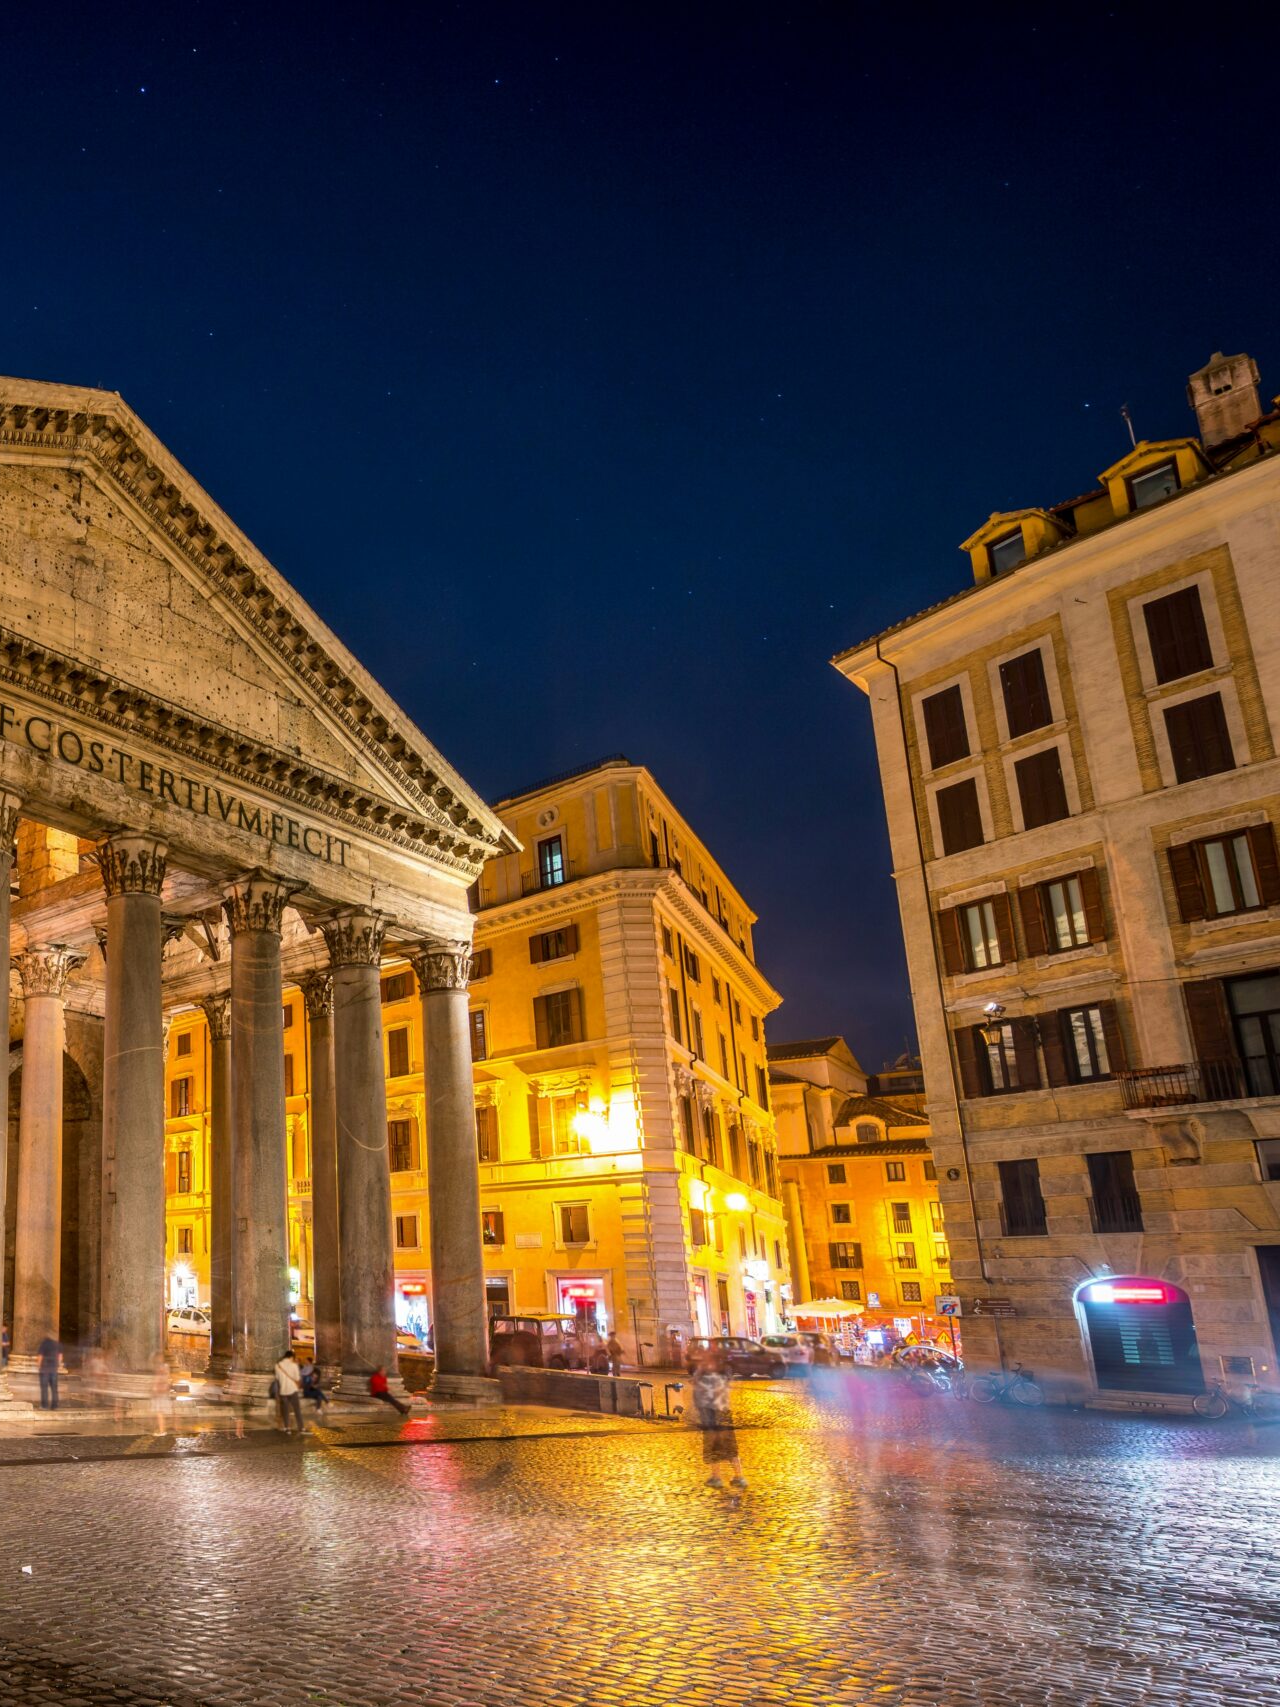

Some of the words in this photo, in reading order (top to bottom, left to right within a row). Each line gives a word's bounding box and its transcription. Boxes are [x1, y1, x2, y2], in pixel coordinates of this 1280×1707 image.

[24, 716, 106, 774] COS
[112, 748, 265, 838] TERTIVM
[270, 811, 352, 867] FECIT
